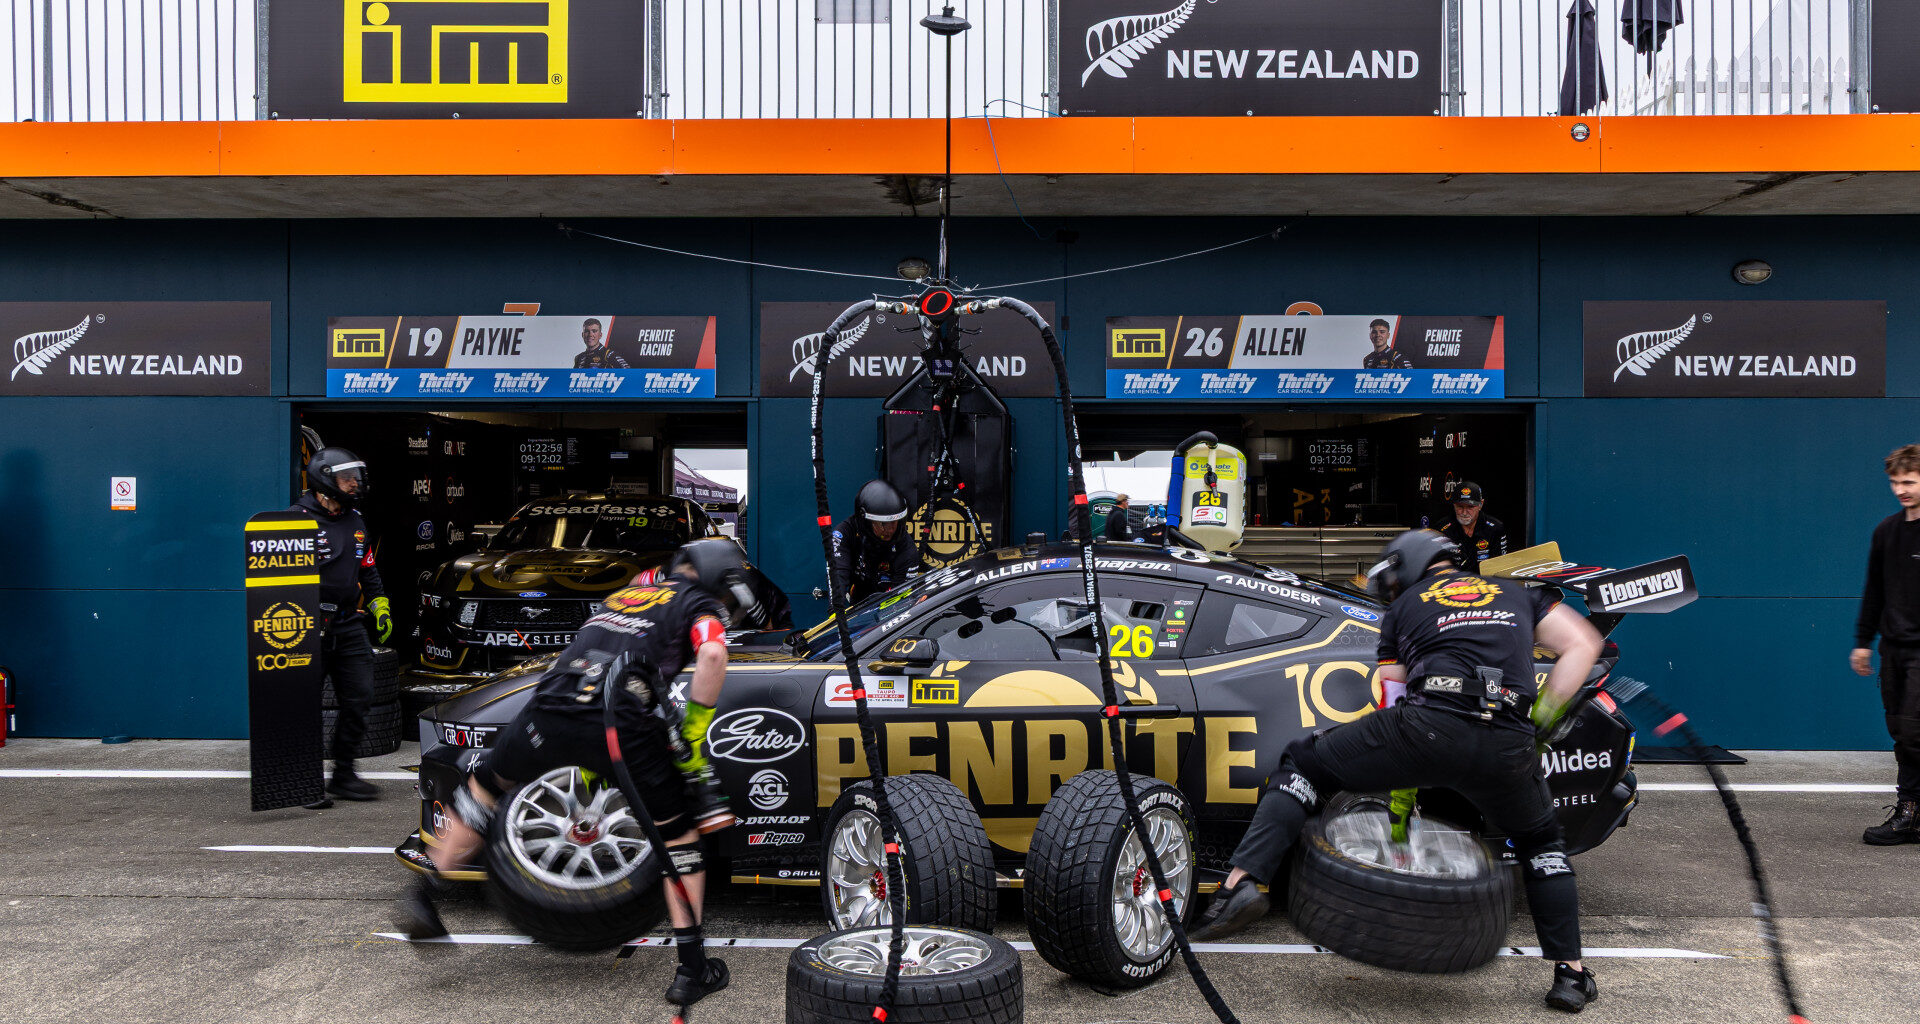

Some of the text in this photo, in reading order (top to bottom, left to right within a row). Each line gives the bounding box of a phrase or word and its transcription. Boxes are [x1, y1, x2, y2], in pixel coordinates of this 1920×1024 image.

[1166, 49, 1420, 79] NEW ZEALAND
[408, 327, 443, 357] 19
[461, 327, 525, 356] PAYNE
[638, 329, 675, 342] PENRITE
[1183, 327, 1224, 357] 26
[1242, 327, 1307, 356] ALLEN
[1425, 329, 1462, 342] PENRITE
[640, 343, 673, 356] RACING
[1427, 343, 1460, 357] RACING
[69, 354, 243, 376] NEW ZEALAND
[850, 356, 906, 377] NEW
[1674, 354, 1857, 377] NEW ZEALAND
[344, 373, 399, 393] Thrifty
[419, 373, 474, 393] Thrifty
[494, 373, 549, 393] Thrifty
[569, 373, 624, 393] Thrifty
[644, 373, 700, 393] Thrifty
[1124, 373, 1181, 394] Thrifty
[1201, 373, 1258, 394] Thrifty
[1278, 373, 1335, 394] Thrifty
[1355, 373, 1412, 394] Thrifty
[1432, 373, 1489, 394] Thrifty
[1309, 444, 1353, 454] 01:22:56
[1446, 431, 1467, 449] GROVE
[520, 454, 562, 464] 09:12:02
[1310, 455, 1352, 465] 09:12:02
[1199, 491, 1221, 506] 26
[529, 503, 648, 517] Steadfast
[627, 516, 648, 528] 19
[250, 540, 267, 553] 19
[268, 538, 315, 552] PAYNE
[248, 553, 315, 569] 26 ALLEN
[974, 560, 1037, 585] ALLEN
[1235, 576, 1322, 607] AUTODESK
[1598, 568, 1684, 607] Floorway
[253, 616, 315, 633] PENRITE
[1437, 610, 1492, 626] RACING
[483, 631, 578, 648] APEX STEE
[1109, 624, 1154, 658] 26
[445, 728, 485, 748] GROVE
[709, 714, 801, 758] Gates
[1541, 749, 1612, 779] Midea
[748, 783, 789, 796] ACL
[1158, 792, 1184, 811] MAXX
[1553, 794, 1597, 808] STEEL
[745, 816, 811, 826] DUNLOP
[762, 831, 805, 846] Repco
[1122, 952, 1172, 979] DUNLOP
